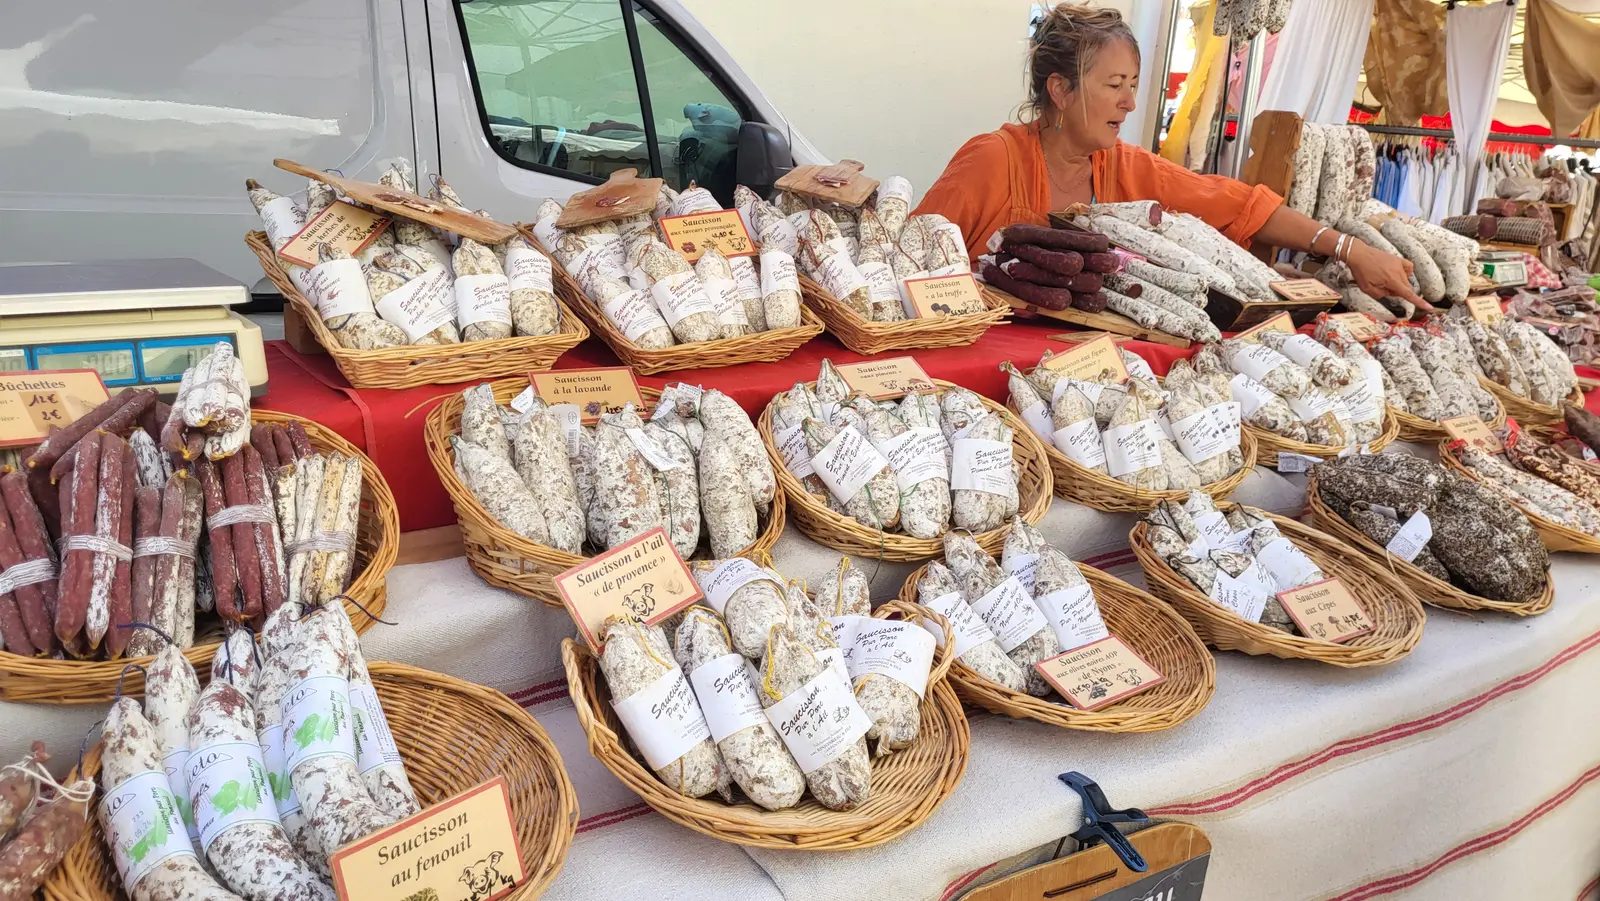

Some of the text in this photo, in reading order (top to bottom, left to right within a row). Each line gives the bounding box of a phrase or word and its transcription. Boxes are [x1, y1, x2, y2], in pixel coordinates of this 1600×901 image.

[300, 212, 334, 242] Saucisson
[319, 224, 338, 242] herbes
[338, 215, 346, 224] de
[682, 216, 722, 228] Saucisson
[683, 227, 704, 236] saveurs
[704, 222, 737, 233] provençales
[473, 282, 508, 297] Saucisson
[924, 280, 961, 290] Saucisson
[944, 290, 963, 299] truffe
[400, 281, 427, 312] Saucisson
[613, 293, 638, 321] Saucisson
[857, 363, 897, 374] Saucisson
[1053, 359, 1081, 372] Saucisson
[0, 380, 66, 392] Bûchettes
[554, 375, 602, 384] Saucisson
[553, 384, 612, 395] à la lavande
[41, 409, 62, 421] 2€
[1181, 414, 1206, 440] Saucisson
[825, 431, 850, 472] Saucisson
[888, 432, 919, 462] Saucisson
[975, 446, 1010, 460] Saucisson
[576, 552, 632, 587] Saucisson
[634, 547, 642, 558] à
[602, 558, 659, 594] de provence
[707, 559, 743, 594] Saucisson
[981, 586, 1009, 624] Saucisson
[1295, 588, 1331, 604] Saucisson
[1059, 617, 1072, 627] Pur
[1071, 606, 1085, 617] Porc
[1304, 607, 1318, 616] aux
[856, 626, 905, 645] Saucisson
[861, 640, 876, 648] Pur
[874, 641, 895, 651] l'Ail
[1056, 650, 1119, 679] aux olives noires AOP
[1058, 647, 1102, 667] Saucisson
[1082, 662, 1117, 681] de Nyons
[651, 674, 685, 720] Saucisson
[728, 682, 743, 694] Pur
[665, 703, 680, 719] Pur
[780, 686, 820, 736] Saucisson
[794, 701, 824, 736] Pur Porc
[812, 710, 829, 732] l'Ail
[378, 811, 469, 866] Saucisson
[391, 832, 473, 888] au fenouil
